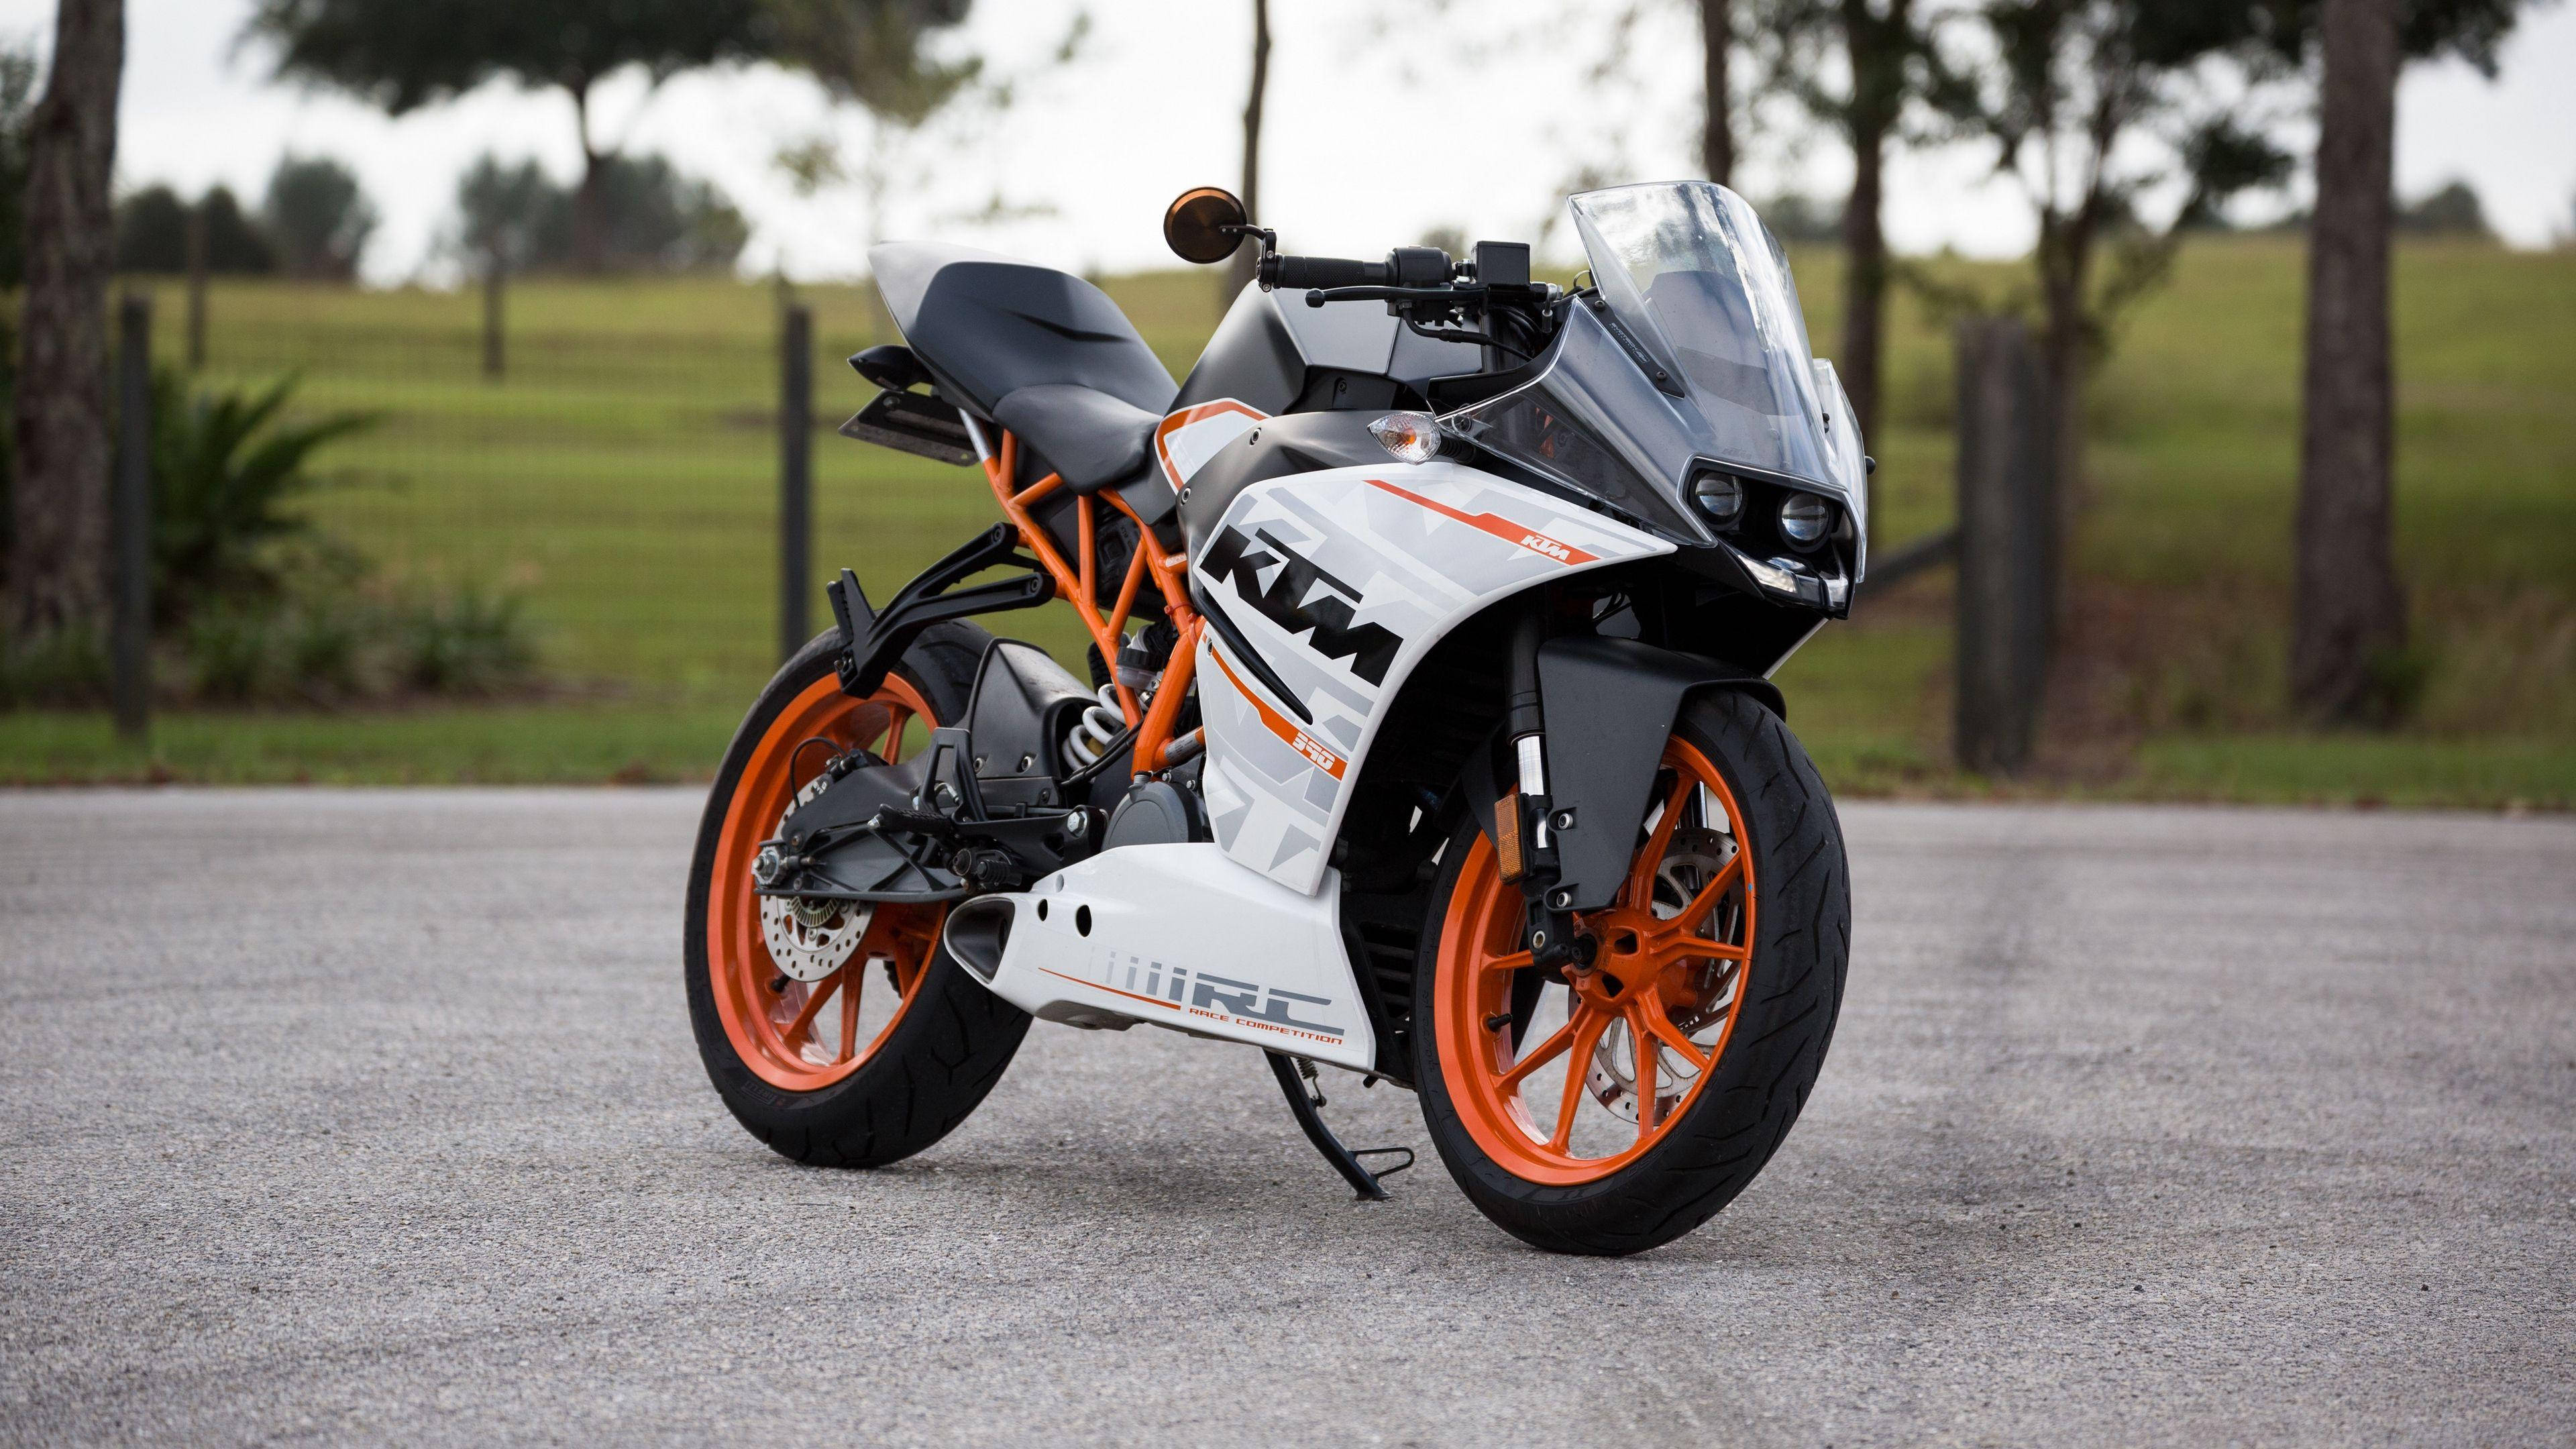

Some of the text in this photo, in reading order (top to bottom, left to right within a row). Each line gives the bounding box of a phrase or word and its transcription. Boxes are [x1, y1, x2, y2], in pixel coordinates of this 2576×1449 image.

[1520, 535, 1570, 560] KTM
[1199, 525, 1404, 688] KTM
[1292, 731, 1335, 770] 390
[1193, 973, 1344, 1036] RC
[1189, 1008, 1342, 1045] RACE COMPETITION
